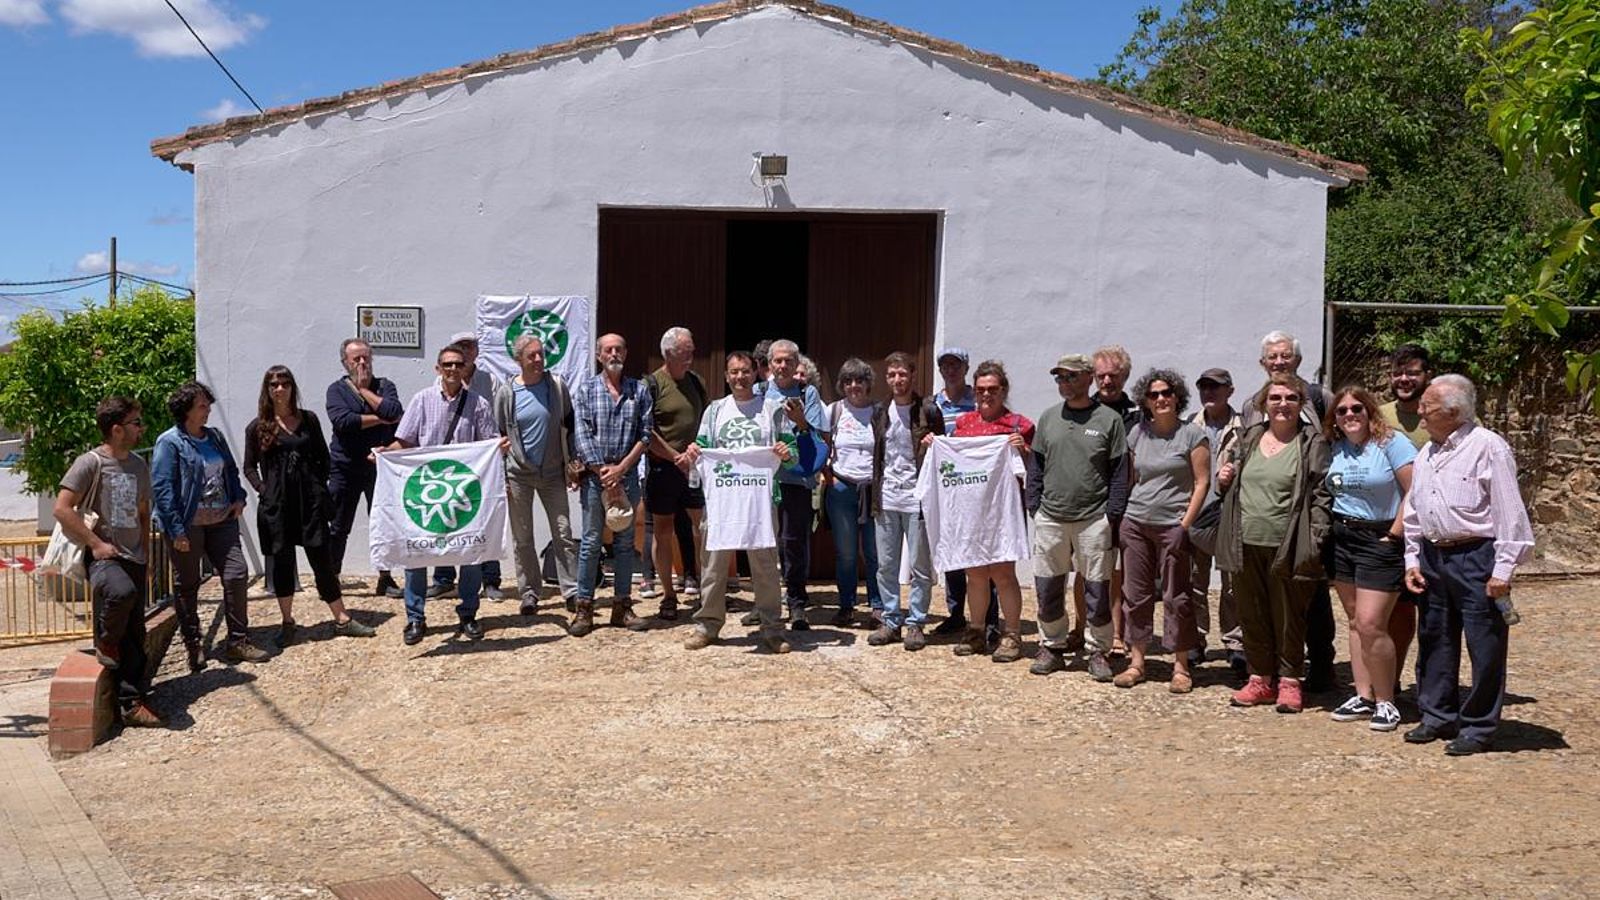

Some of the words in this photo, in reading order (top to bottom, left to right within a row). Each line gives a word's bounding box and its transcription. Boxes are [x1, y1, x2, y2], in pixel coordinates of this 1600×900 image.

[376, 320, 416, 328] CULTURAL
[362, 331, 382, 343] BLAS
[383, 331, 417, 344] INFANTE
[406, 534, 487, 549] ECOLOGISTAS
